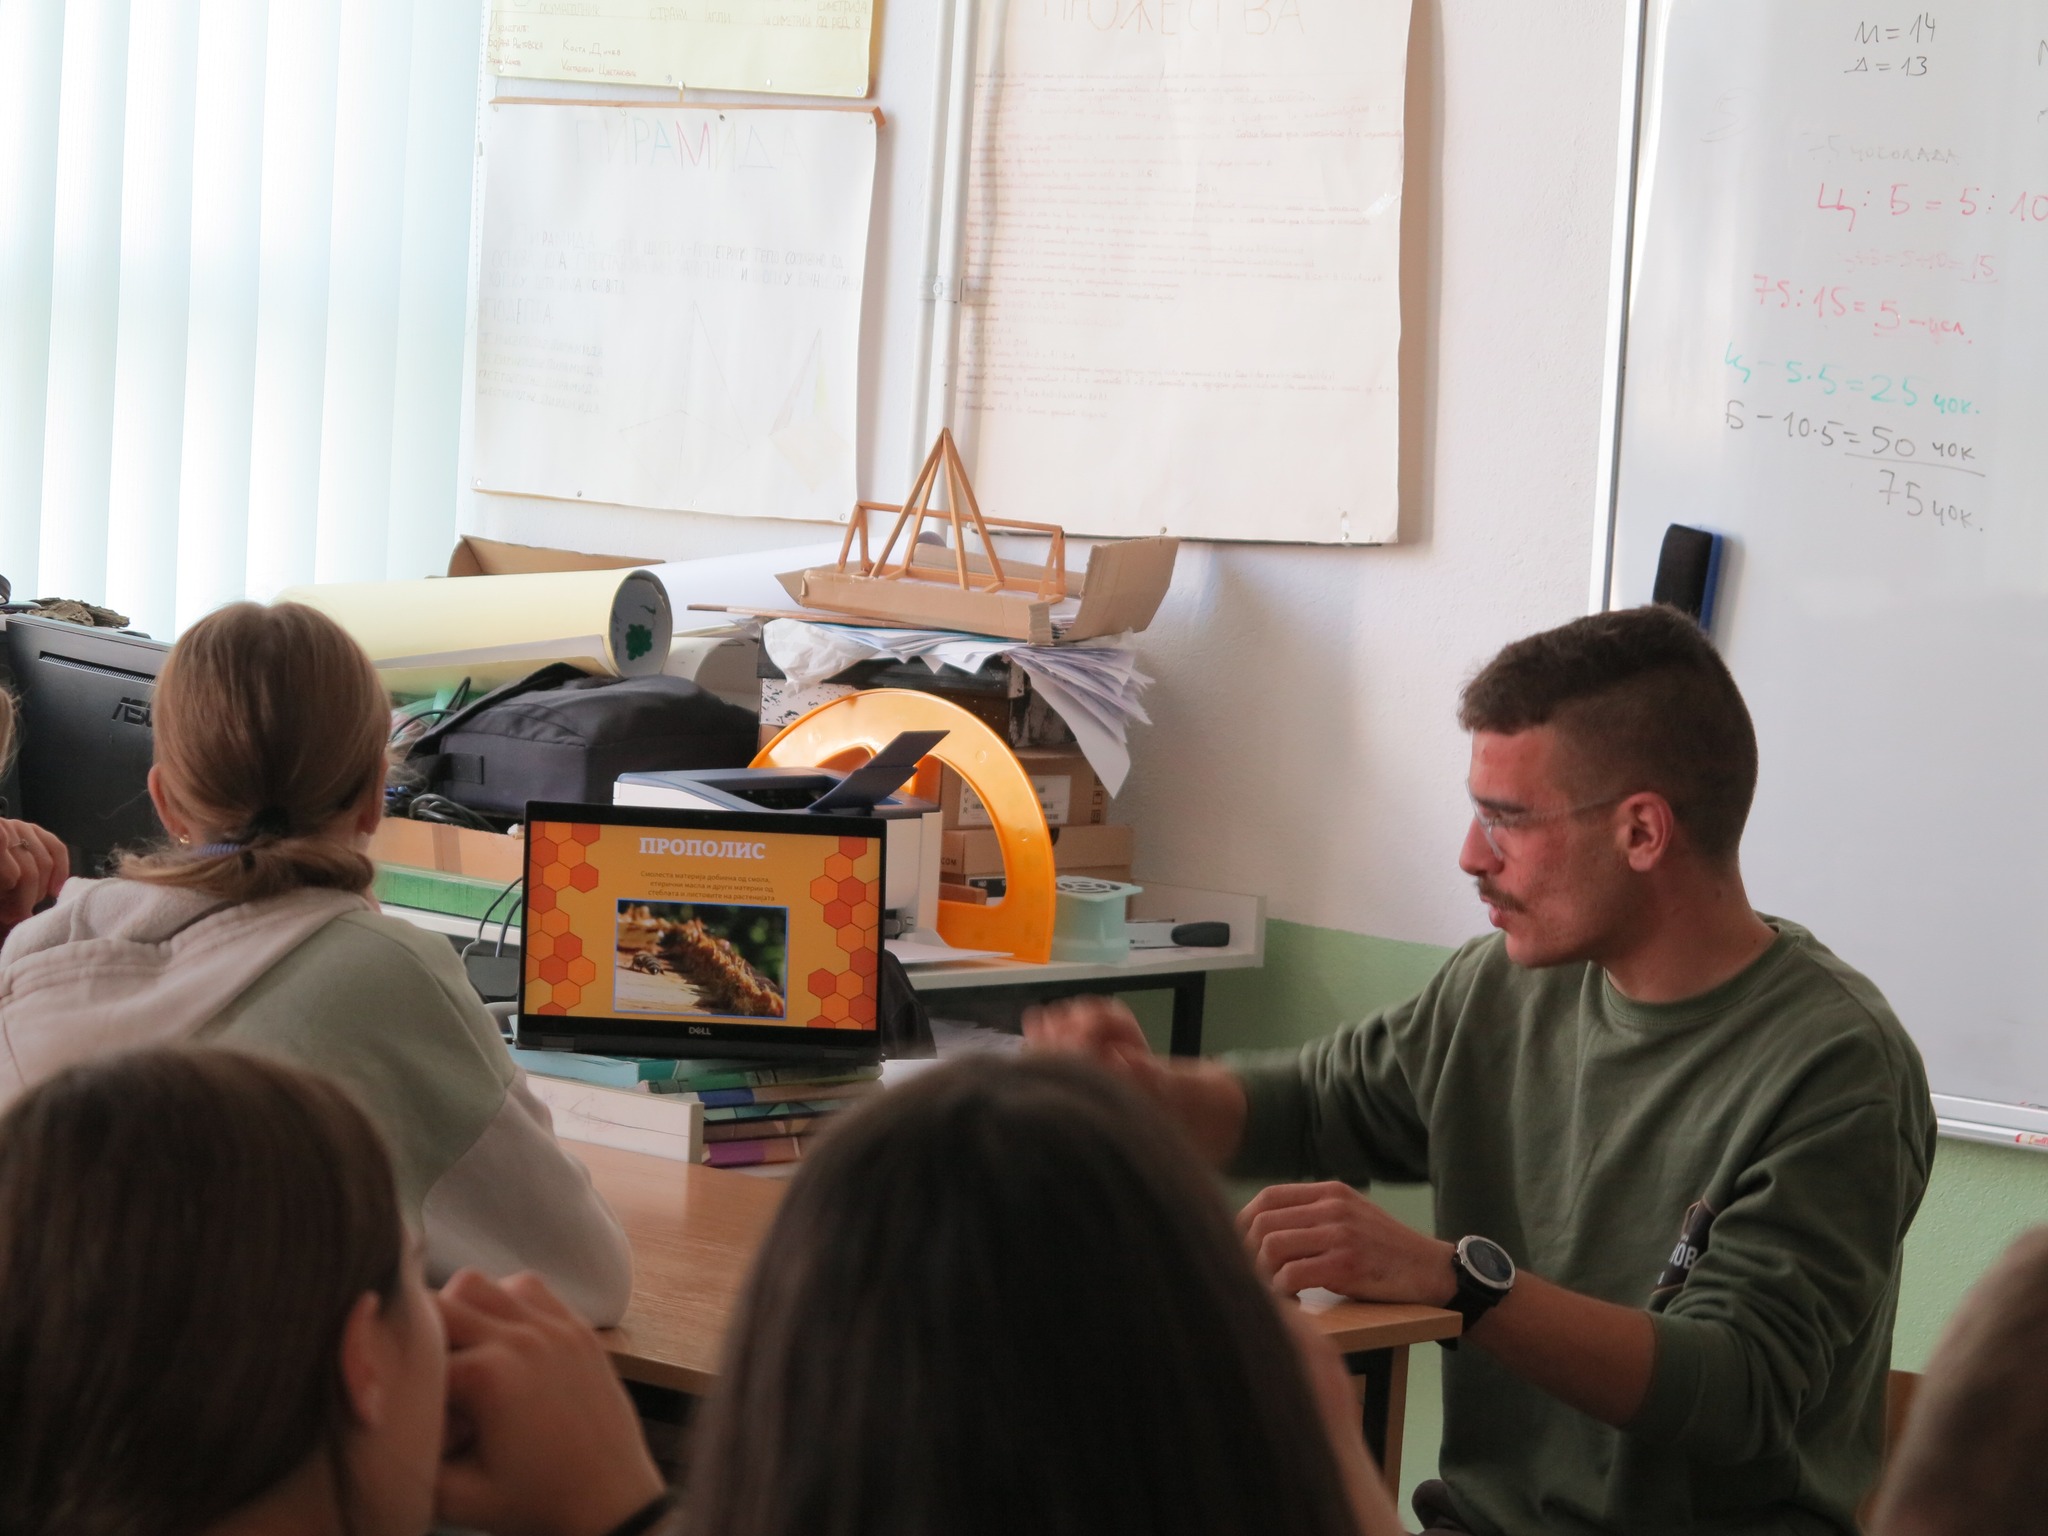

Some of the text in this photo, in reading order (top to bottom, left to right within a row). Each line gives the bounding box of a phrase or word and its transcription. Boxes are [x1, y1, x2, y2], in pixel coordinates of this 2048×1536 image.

[1909, 12, 1936, 44] 14
[1900, 56, 1928, 77] 13
[638, 837, 767, 860] ПРОПОЛИС
[640, 870, 674, 880] Смолеста
[674, 872, 706, 881] материја
[707, 873, 737, 882] добиена
[748, 876, 772, 884] смола,
[650, 880, 684, 889] етерични
[685, 882, 706, 890] масла
[712, 883, 733, 891] други
[648, 889, 679, 898] стеблата
[686, 891, 723, 899] листовите
[733, 893, 776, 903] растенијата
[689, 1026, 712, 1036] DELL
